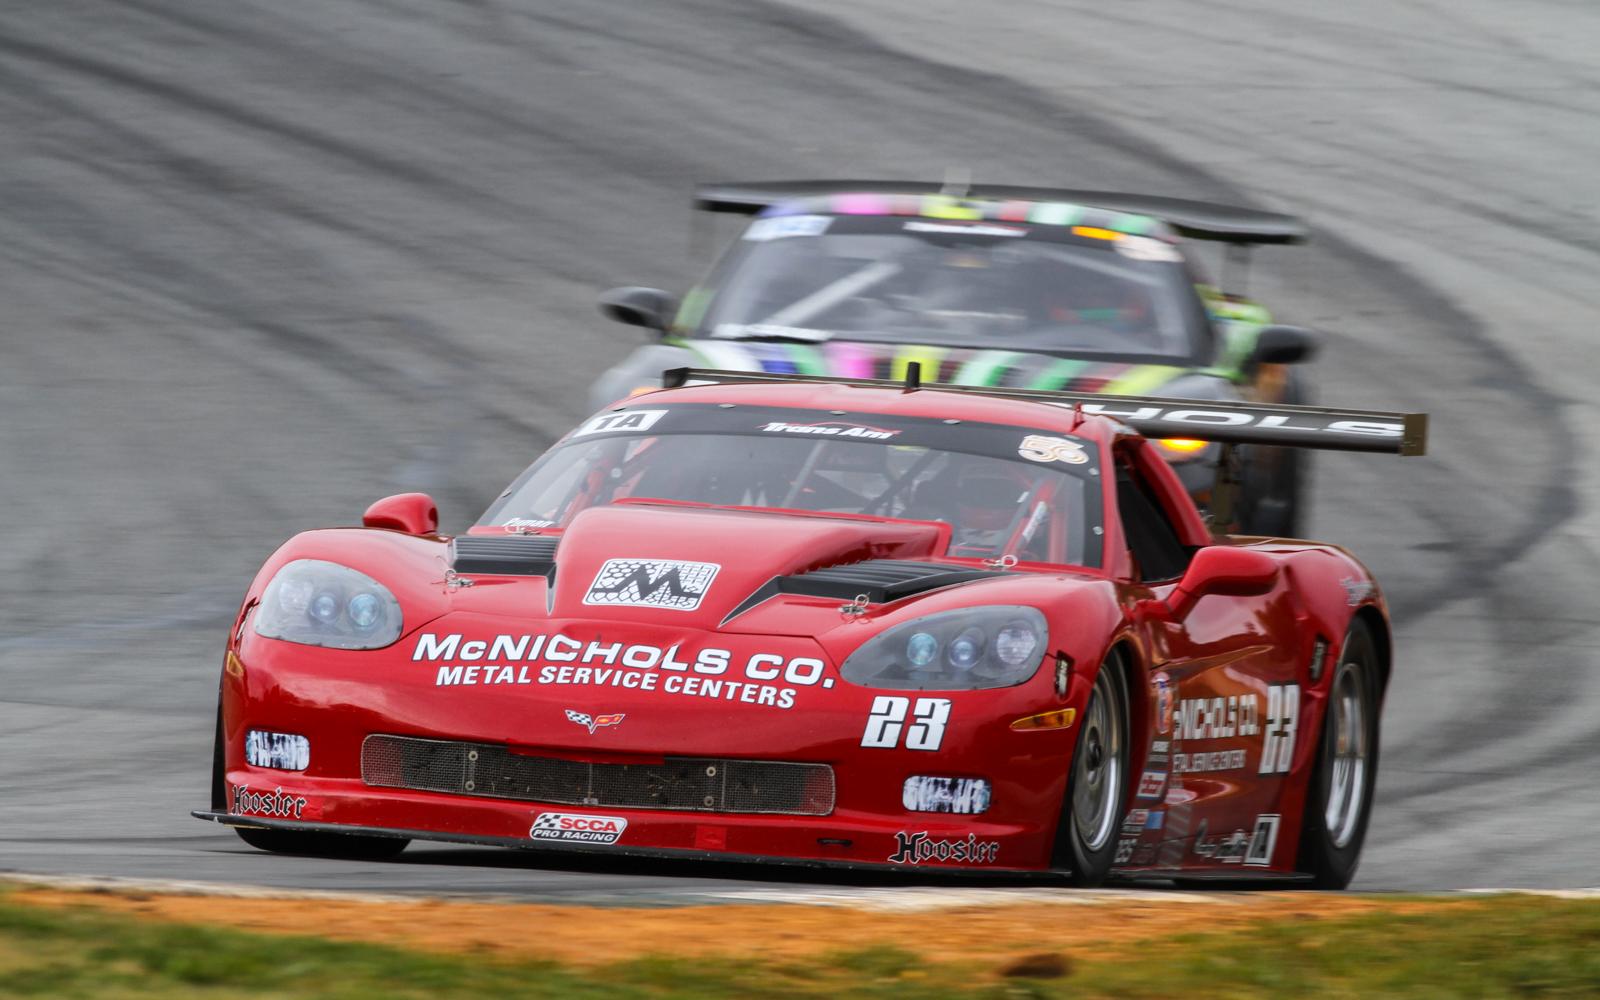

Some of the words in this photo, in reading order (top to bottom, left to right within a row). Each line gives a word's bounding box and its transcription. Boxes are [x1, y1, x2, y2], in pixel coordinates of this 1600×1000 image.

[594, 413, 647, 431] TA
[762, 422, 843, 434] Trans
[837, 427, 893, 439] Am
[1040, 401, 1404, 437] HOLS
[412, 632, 731, 674] McNICHOLS
[744, 653, 836, 689] CO.
[435, 665, 532, 687] METAL
[538, 667, 659, 691] SERVICE
[663, 675, 797, 710] CENTERS
[860, 695, 952, 751] 23
[230, 784, 307, 819] Hoosier
[533, 829, 561, 838] PRO
[562, 831, 615, 842] RACING
[559, 817, 618, 833] SCCA
[887, 830, 1000, 864] Hoosier
